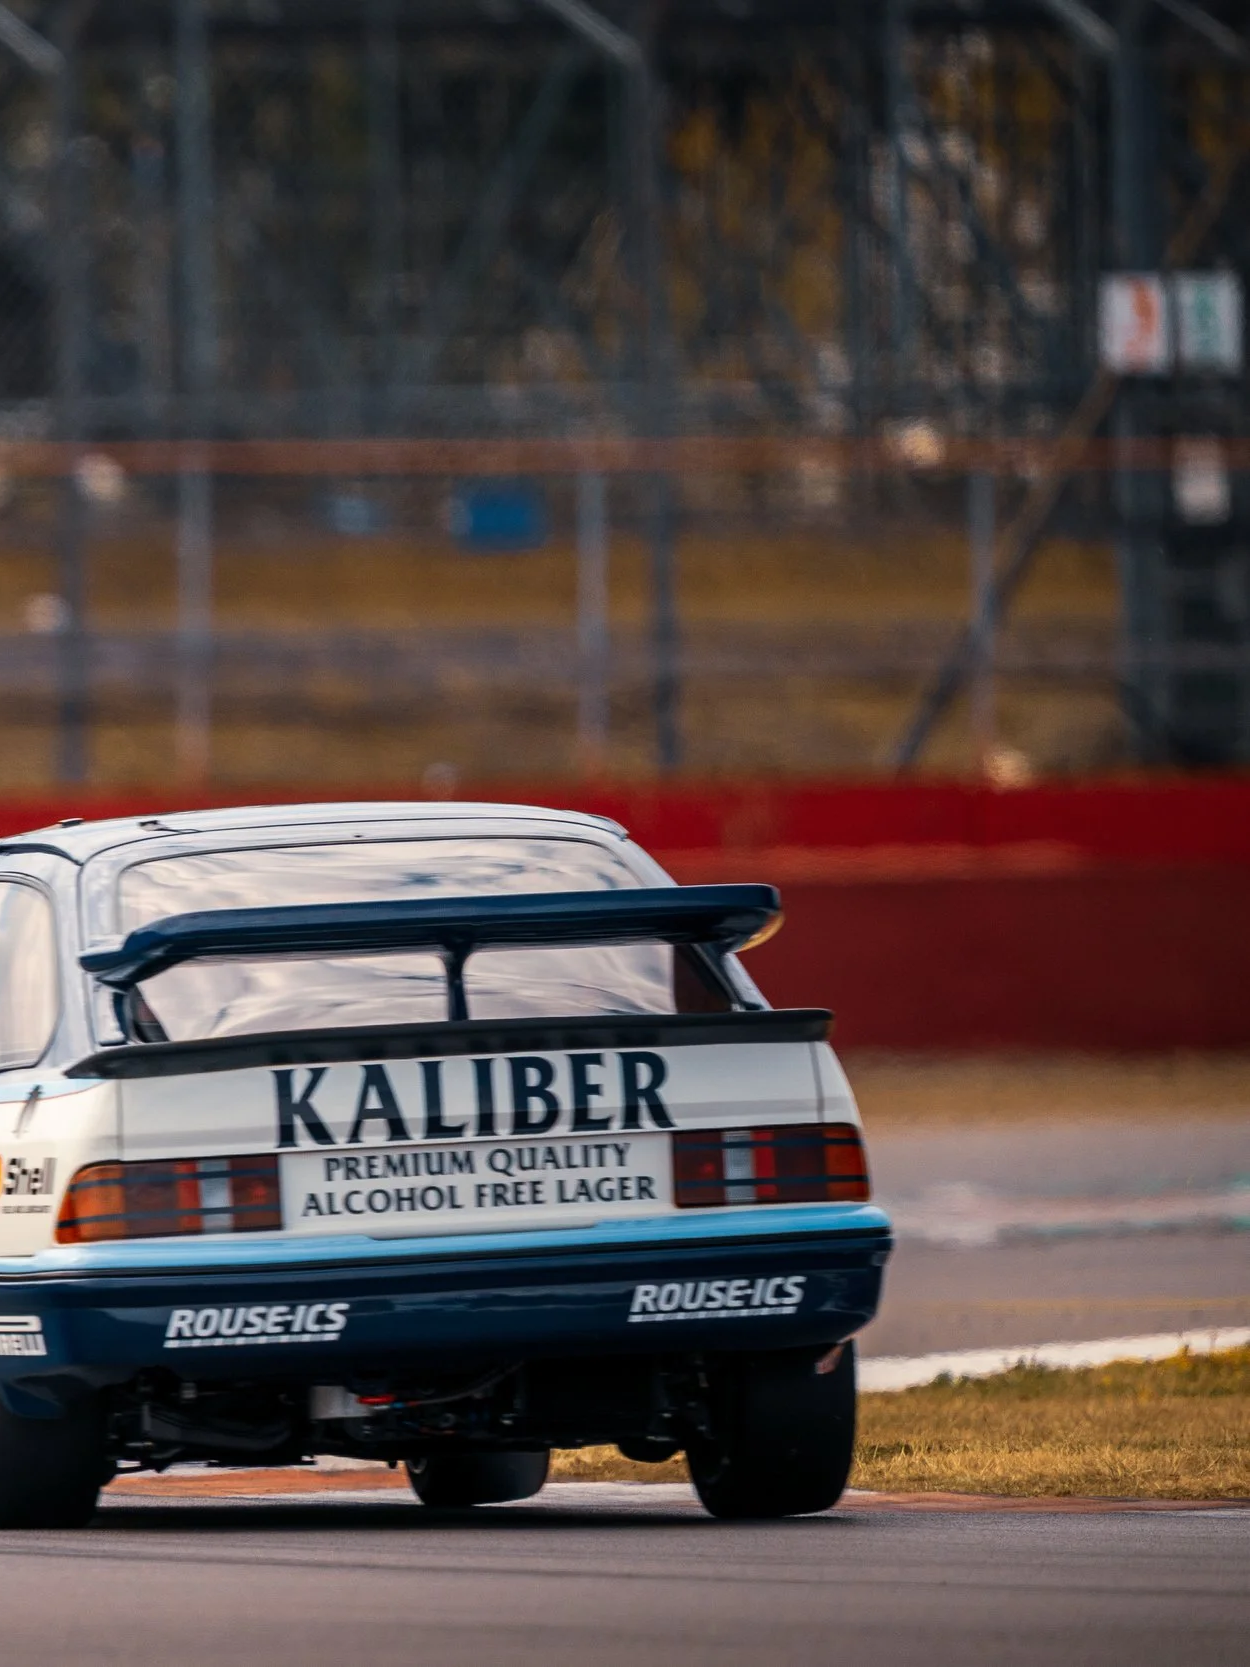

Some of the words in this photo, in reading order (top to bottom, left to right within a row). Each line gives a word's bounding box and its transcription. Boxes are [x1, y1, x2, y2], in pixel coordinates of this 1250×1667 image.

[269, 1050, 679, 1149] KALIBER
[2, 1157, 58, 1195] Shell
[324, 1149, 476, 1182] PREMIUM
[487, 1142, 631, 1178] QUALITY
[301, 1184, 465, 1217] ALCOHOL
[476, 1180, 546, 1208] FREE
[556, 1175, 658, 1204] LAGER
[629, 1275, 808, 1313] ROUSE-ICS
[165, 1303, 350, 1339] ROUSE-ICS
